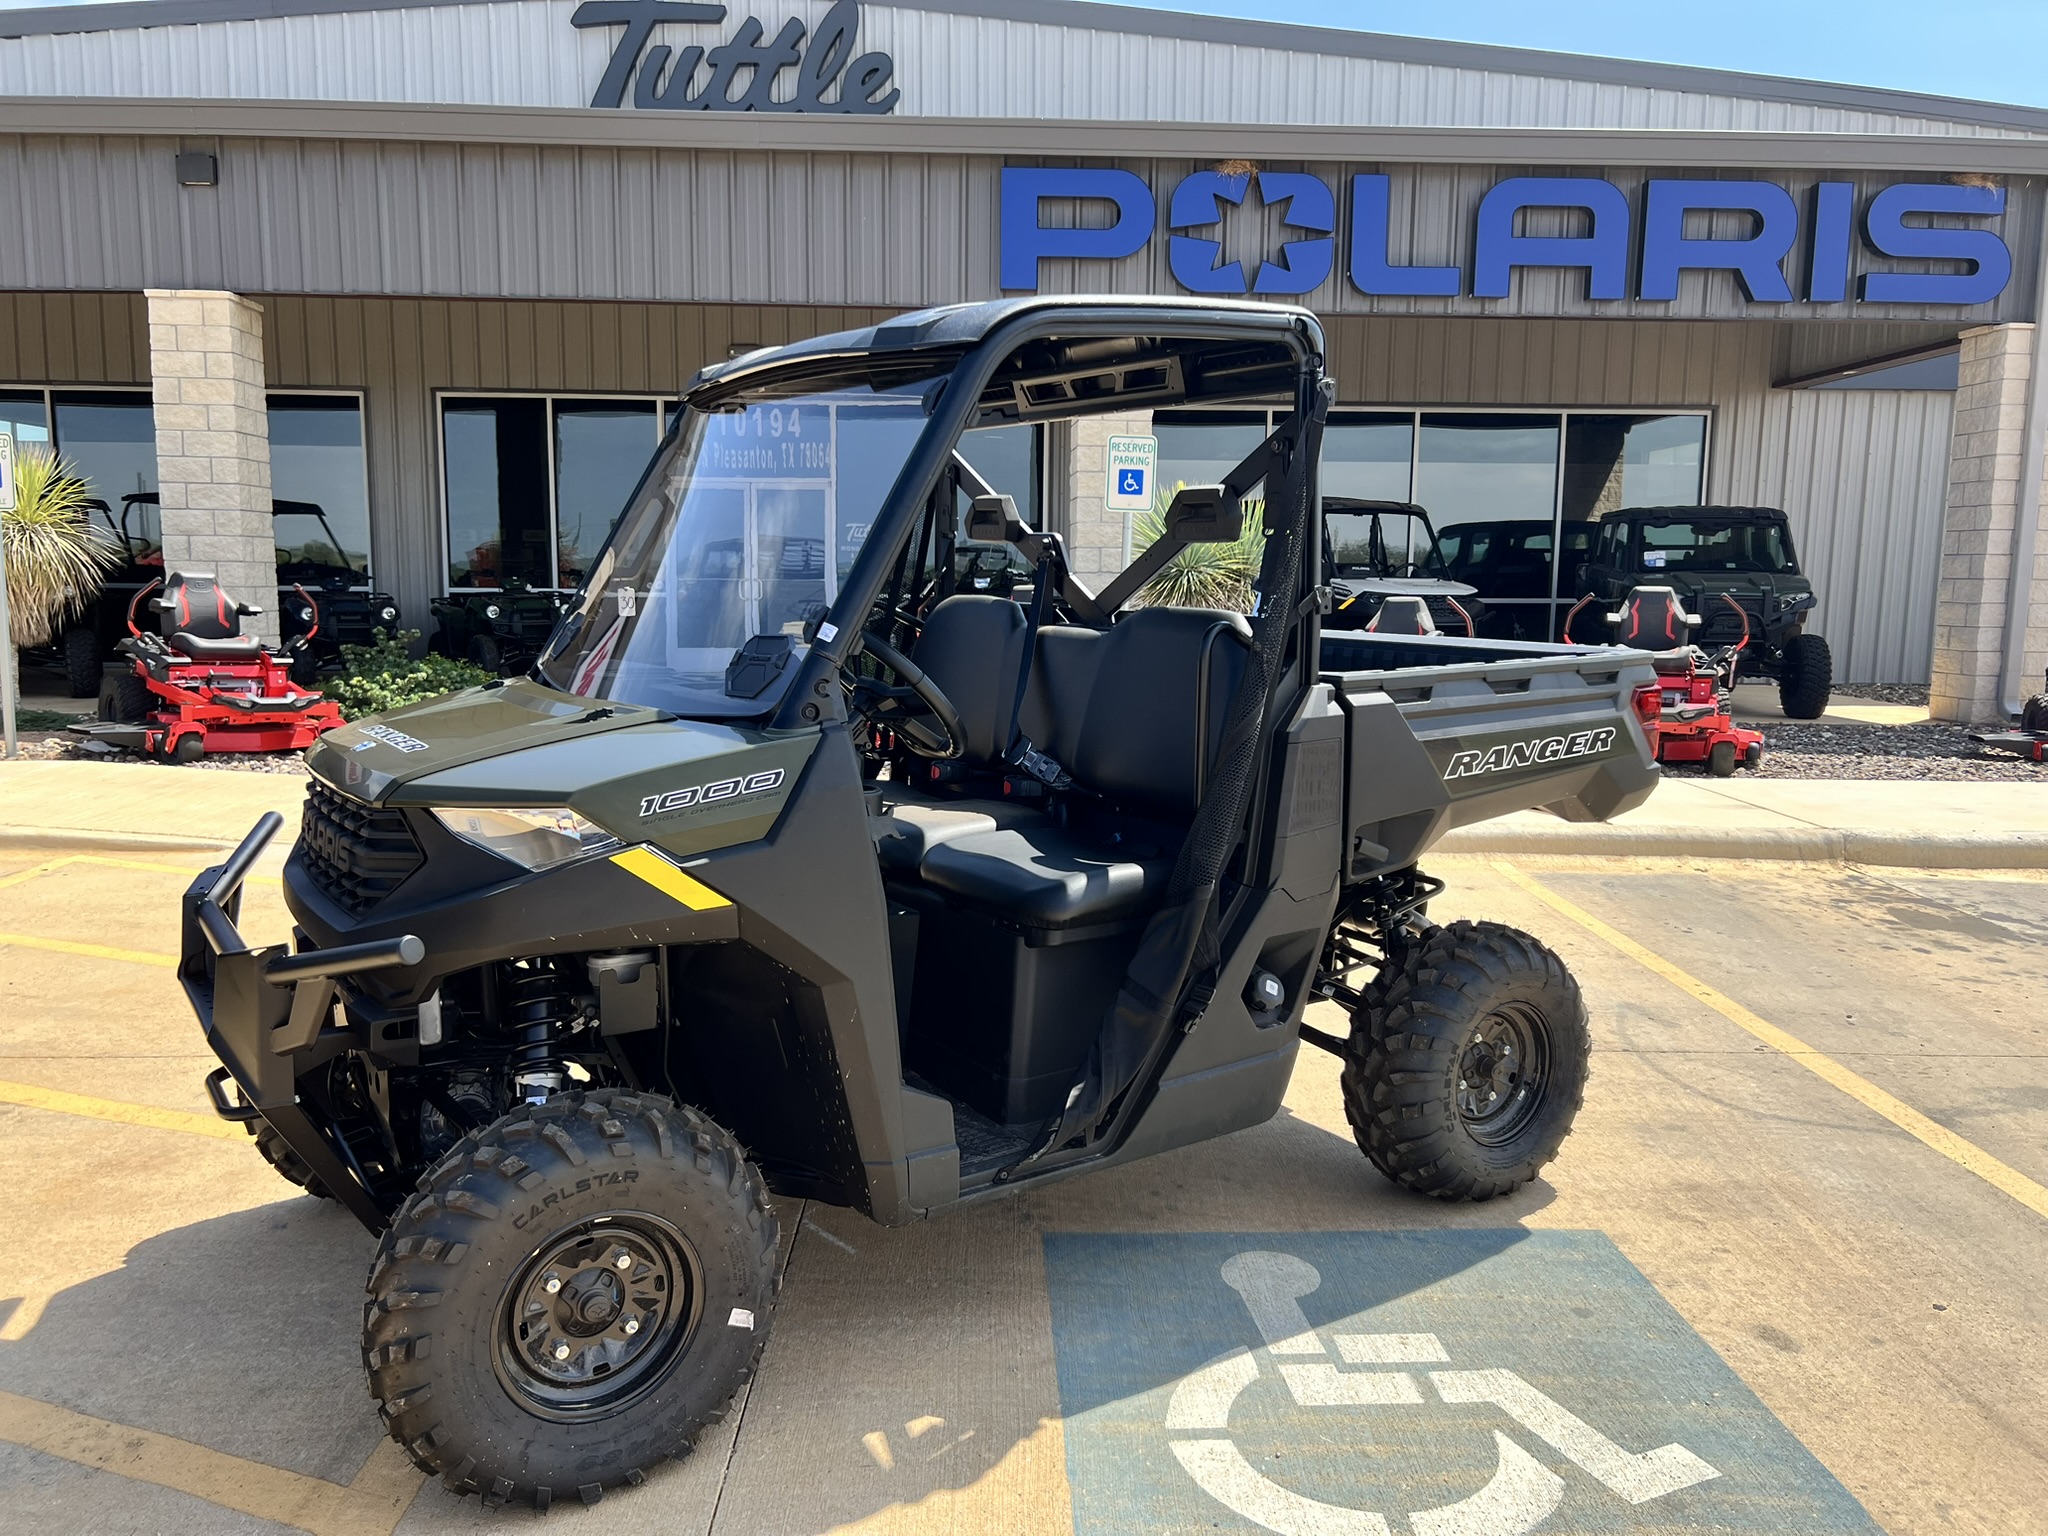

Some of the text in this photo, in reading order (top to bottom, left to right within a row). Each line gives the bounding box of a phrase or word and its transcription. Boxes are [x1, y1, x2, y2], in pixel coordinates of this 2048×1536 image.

[570, 0, 900, 114] Tuttle
[1000, 167, 2012, 305] POLARIS
[716, 407, 802, 438] 10194
[713, 441, 777, 474] Pleasanton,
[781, 442, 795, 468] TX
[1111, 442, 1154, 454] RESERVED
[1113, 455, 1150, 467] PARKING
[620, 596, 635, 609] 30
[1443, 726, 1617, 780] RANGER
[639, 768, 786, 817] 1000
[641, 811, 687, 826] SINGLE
[511, 1169, 640, 1230] CARLSTAR
